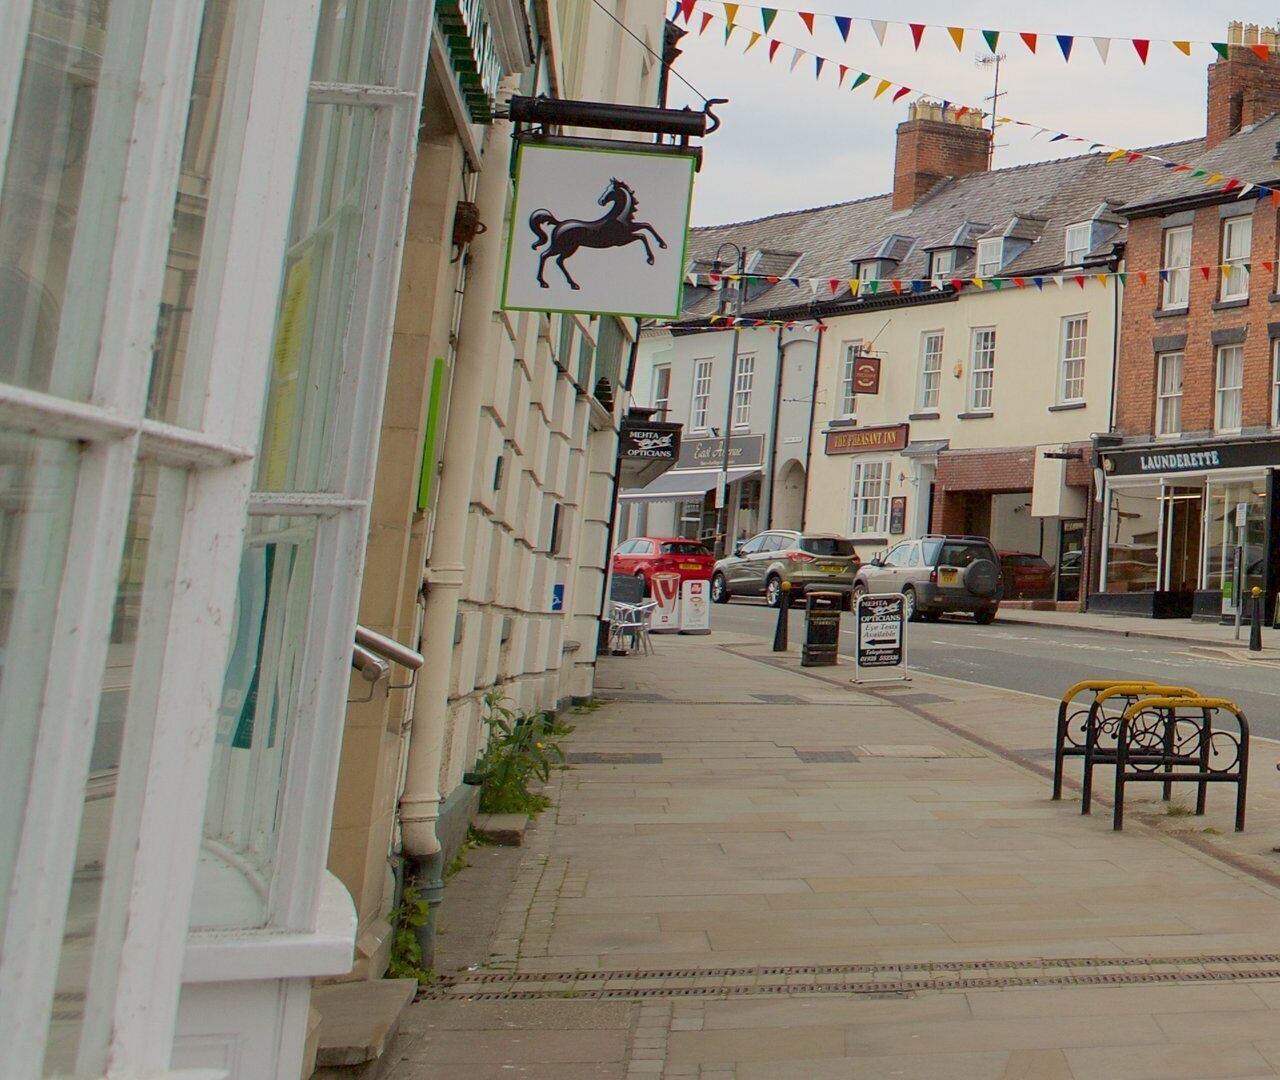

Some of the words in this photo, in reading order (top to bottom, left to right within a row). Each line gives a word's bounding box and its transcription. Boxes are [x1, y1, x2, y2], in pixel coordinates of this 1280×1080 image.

[629, 431, 659, 439] MEHTA
[834, 435, 847, 447] THE
[848, 432, 882, 447] PHEASANT
[883, 431, 897, 444] INN
[627, 449, 672, 457] OPTICIANS
[693, 442, 711, 460] East
[1140, 450, 1220, 470] LAUNDERETTE
[861, 615, 901, 623] OPTICIANS
[866, 624, 879, 632] Eye
[880, 623, 898, 631] Tests
